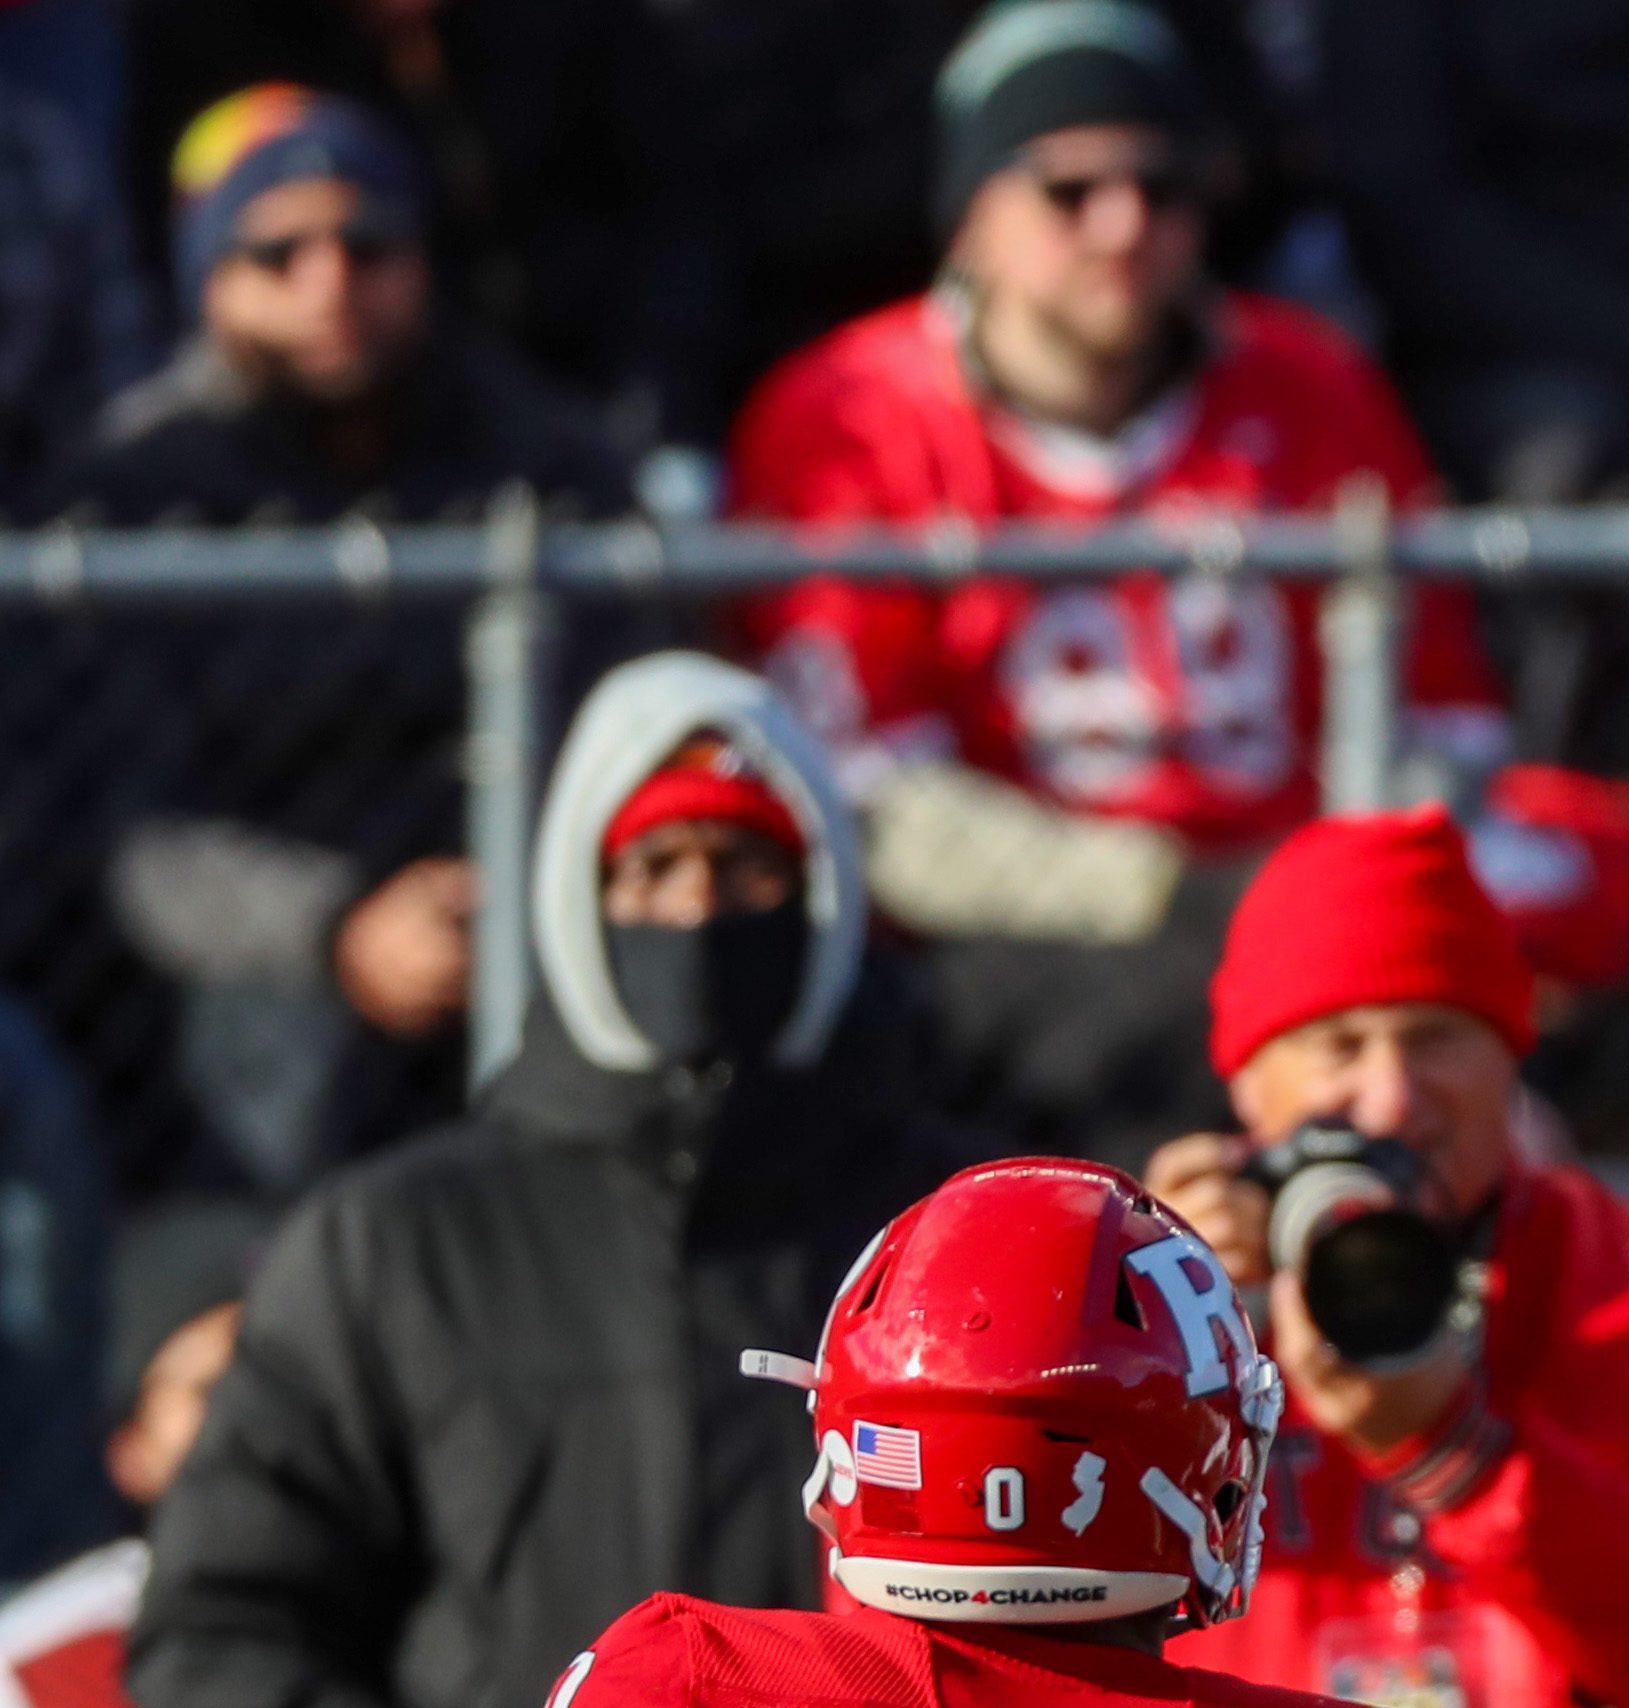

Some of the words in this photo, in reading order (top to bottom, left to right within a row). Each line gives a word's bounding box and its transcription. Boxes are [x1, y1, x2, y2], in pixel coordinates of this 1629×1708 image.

[1122, 1232, 1258, 1398] R
[984, 1465, 1026, 1532] 0
[885, 1583, 1109, 1606] #CHOP4CHANGE
